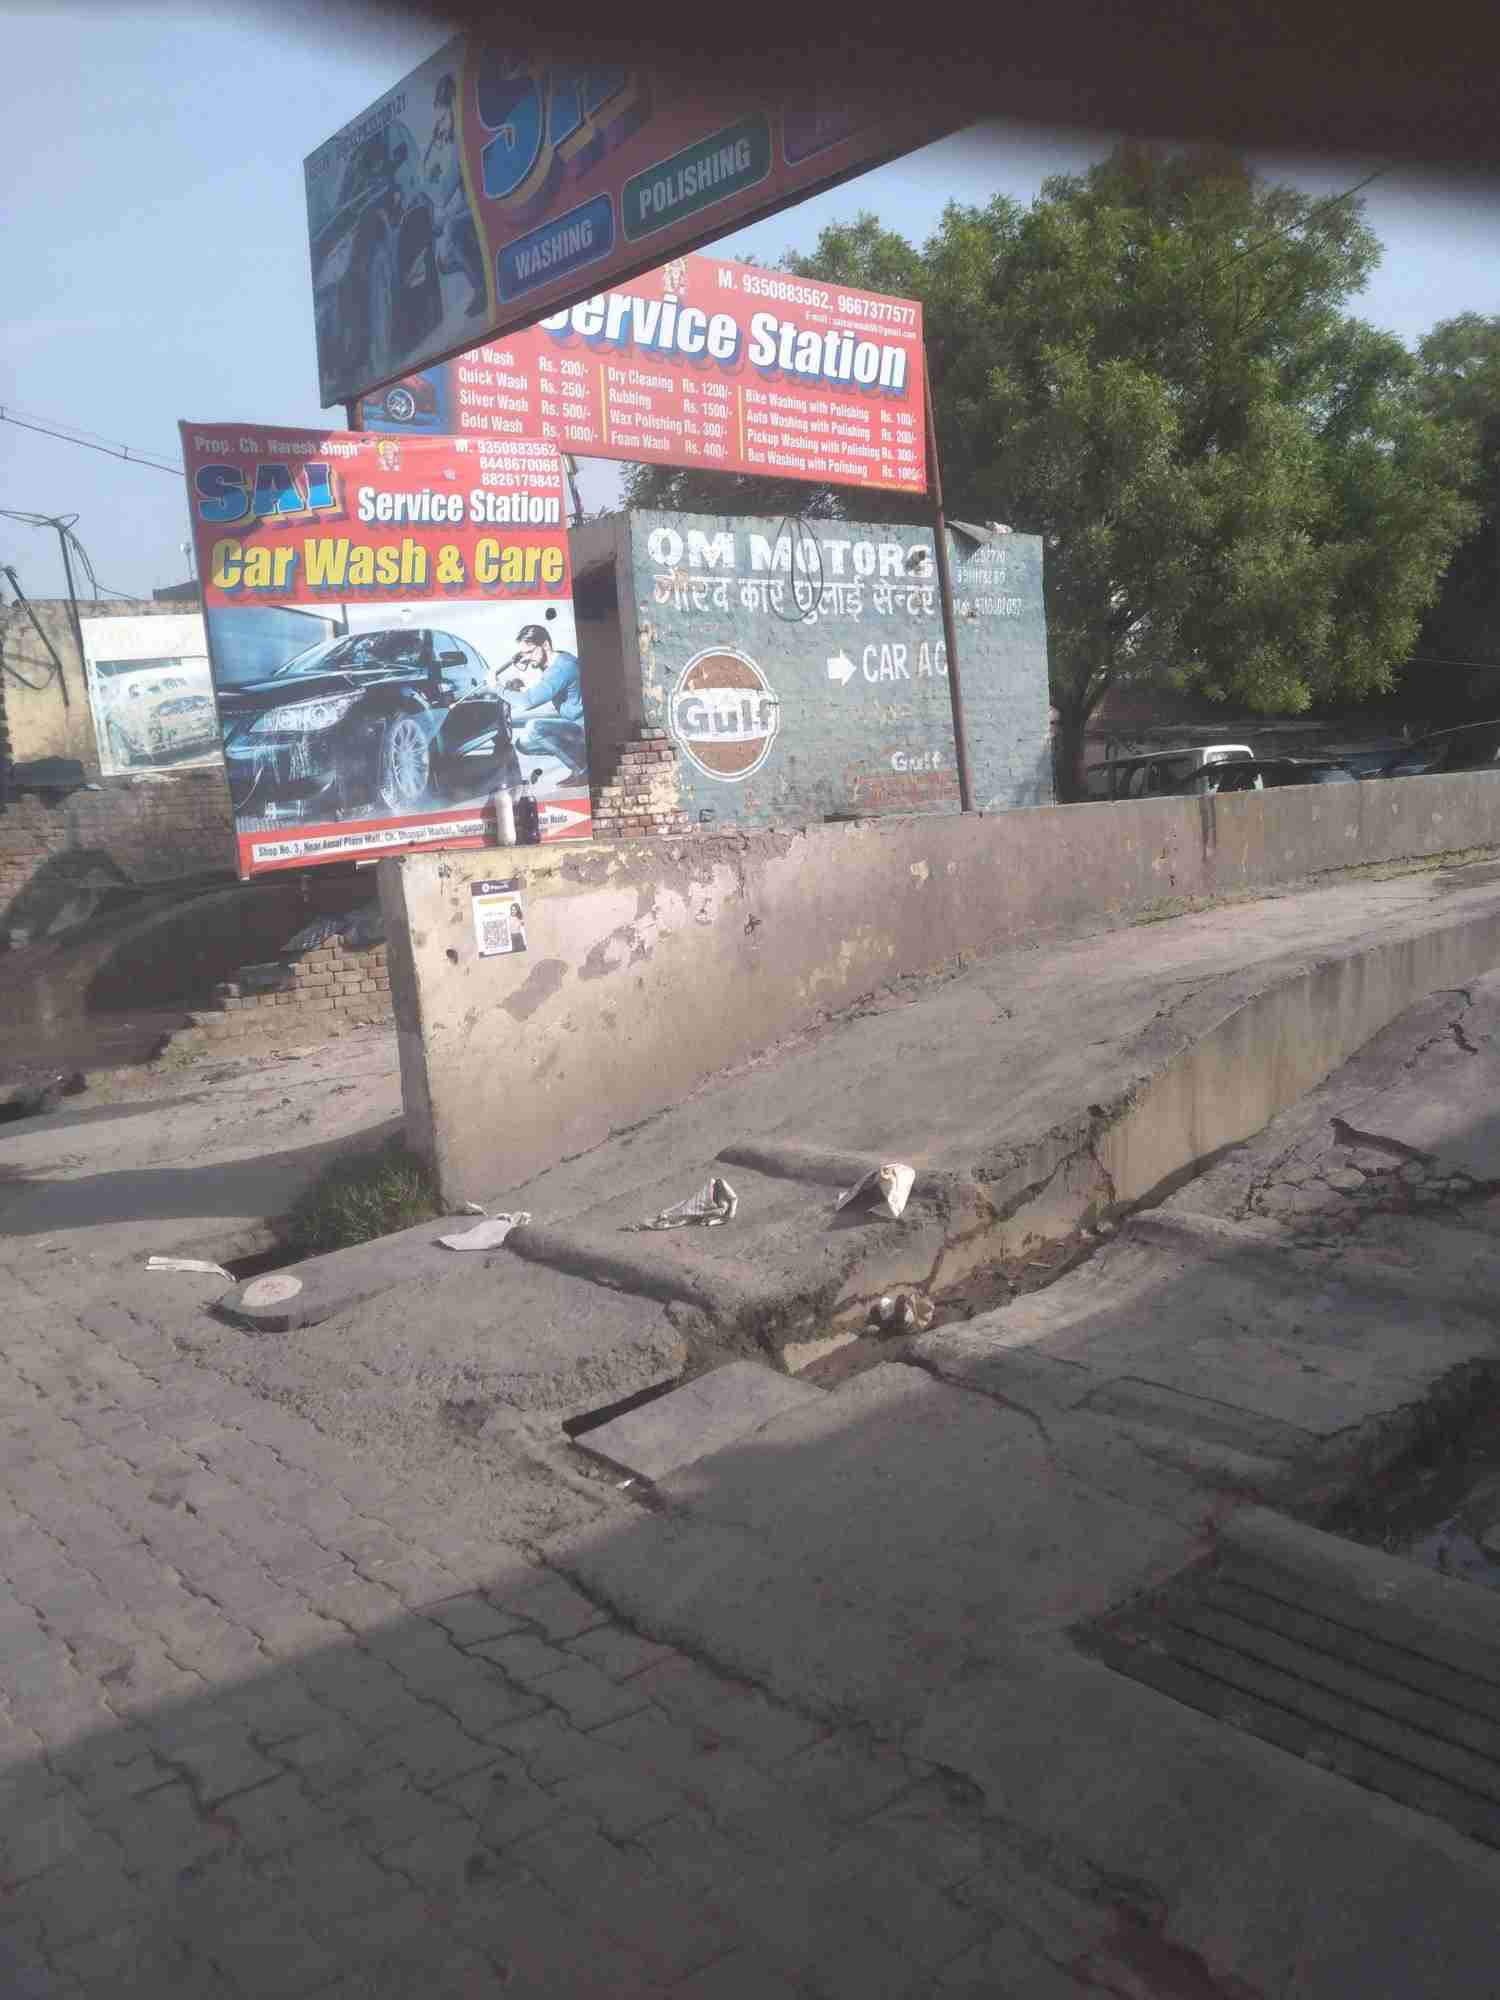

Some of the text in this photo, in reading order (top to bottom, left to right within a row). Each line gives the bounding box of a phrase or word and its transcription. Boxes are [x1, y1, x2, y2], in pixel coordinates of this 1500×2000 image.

[639, 138, 752, 221] POLISHING
[513, 219, 593, 280] WASHING
[718, 268, 738, 289] M.
[483, 348, 514, 366] Wash
[538, 356, 557, 373] Rs.
[560, 360, 589, 377] 200/-
[749, 313, 906, 388] Station
[458, 367, 590, 400] Quick Wash Rs. 250/-
[608, 366, 626, 385] Dry
[628, 370, 673, 392] Cleaning
[682, 378, 698, 394] Rs.
[460, 389, 591, 420] Silver Wash Rs. 500/-
[609, 388, 652, 409] Rubbing
[683, 399, 698, 414] Rs.
[745, 389, 767, 404] Bike
[769, 393, 807, 413] Washing
[809, 400, 828, 415] with
[830, 402, 870, 422] Polishing
[461, 412, 598, 443] Gold Wash Rs. 1000/-
[610, 409, 632, 424] Wax
[635, 413, 683, 435] Polishing
[684, 420, 700, 434] Rs.
[746, 409, 768, 425] Auto
[770, 412, 808, 432] Washing
[810, 419, 829, 434] with
[831, 422, 871, 441] Polishing
[611, 430, 639, 448] Foam
[642, 432, 670, 450] Wash
[685, 439, 701, 455] Rs.
[747, 429, 780, 448] Pickup
[781, 432, 819, 452] Washing
[821, 439, 839, 454] with
[841, 442, 881, 461] Polishing
[768, 451, 806, 471] Washing
[808, 458, 826, 472] with
[828, 460, 868, 479] Polishing
[194, 461, 340, 524] SAI
[358, 486, 560, 523] Service Station
[212, 537, 564, 588] Car Wash & Care
[647, 528, 735, 568] OM
[750, 535, 935, 577] MOTORS
[863, 643, 910, 683] CAR
